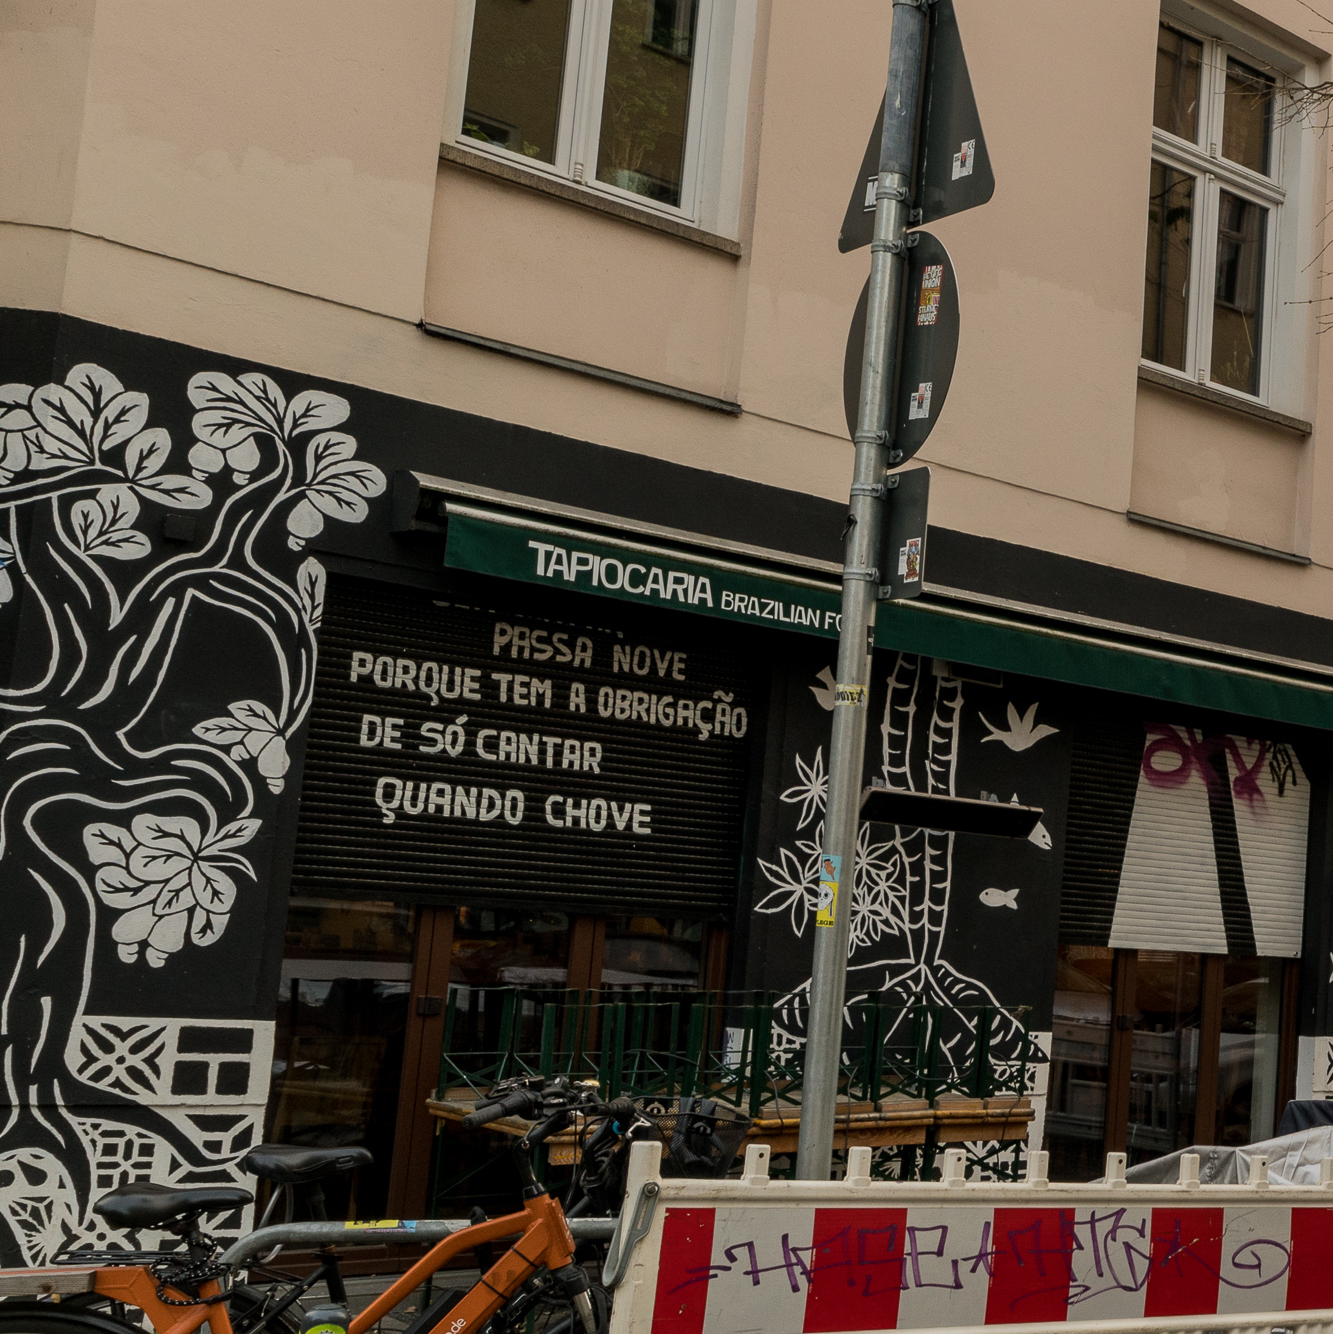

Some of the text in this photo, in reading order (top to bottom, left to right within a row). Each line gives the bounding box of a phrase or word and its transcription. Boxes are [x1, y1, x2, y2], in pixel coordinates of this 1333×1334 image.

[528, 540, 713, 607] TAPIOCARIA
[721, 590, 821, 628] BRAZILIAN
[492, 621, 688, 681] PASSA NOVE
[349, 650, 748, 741] PORQUE TEM A OBRIGAÇÃO
[359, 713, 603, 774] DE SÓ CANTAR
[374, 776, 653, 835] QUANDO CHOVE
